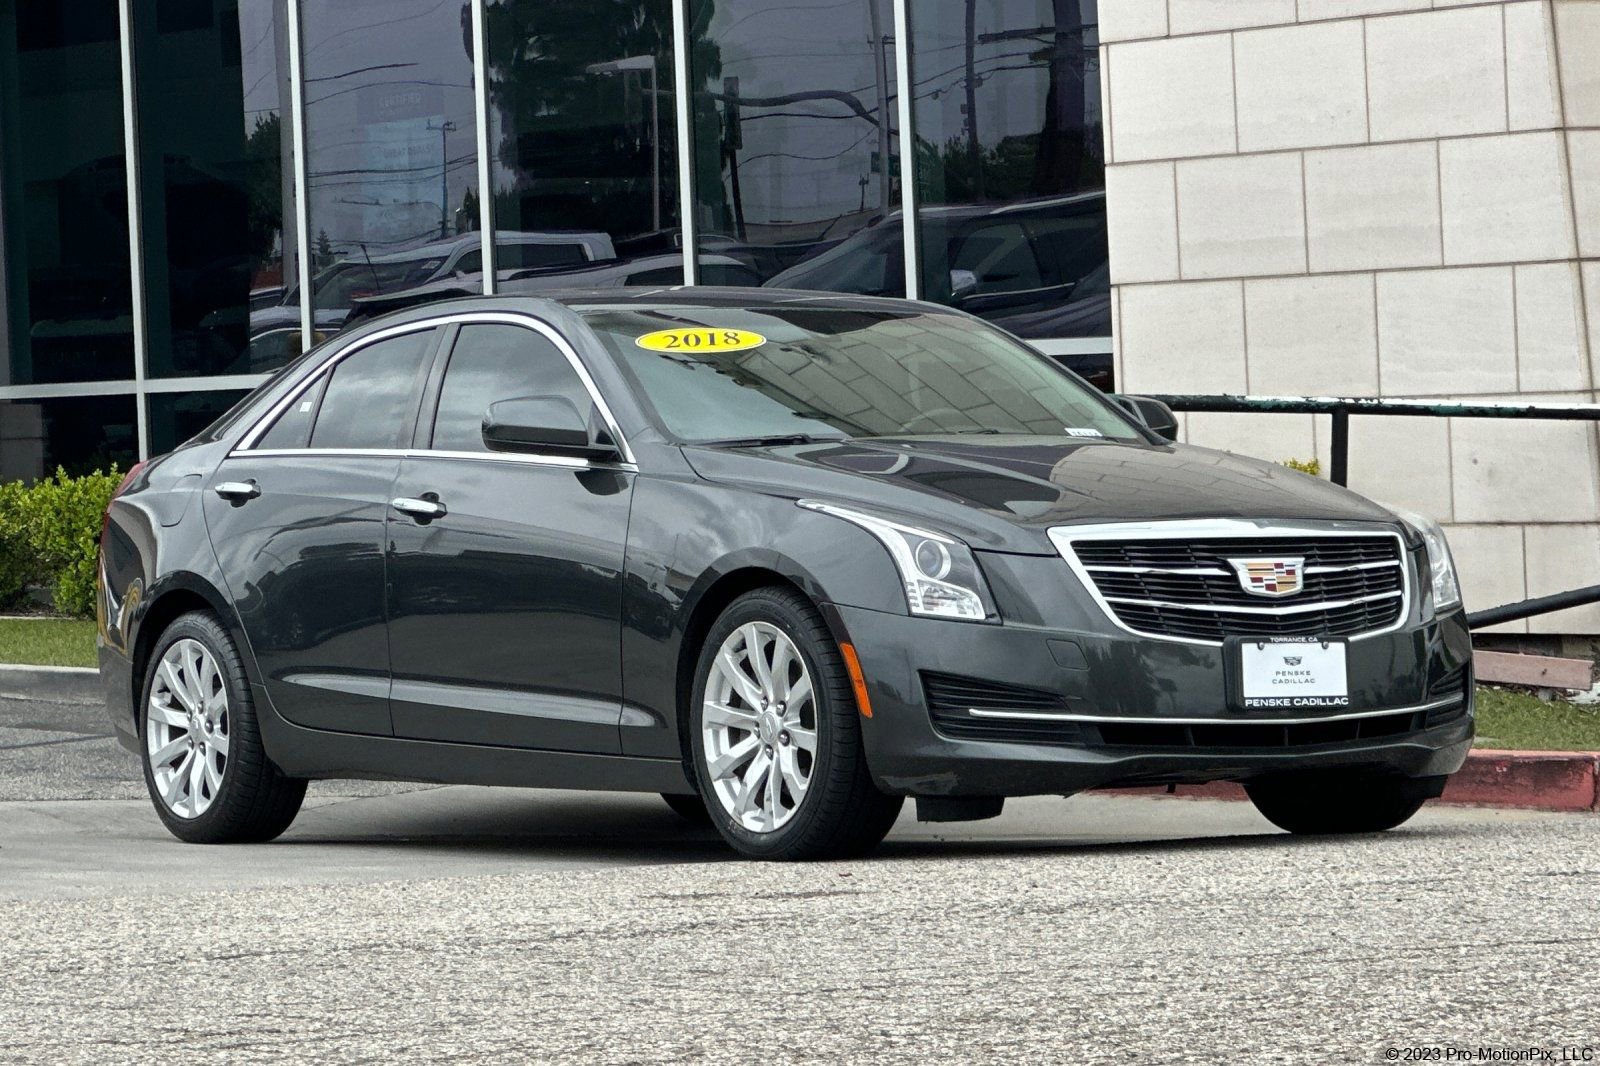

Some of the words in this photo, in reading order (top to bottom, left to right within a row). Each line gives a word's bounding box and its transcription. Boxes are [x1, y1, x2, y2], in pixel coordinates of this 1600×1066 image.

[663, 332, 741, 348] 2018
[1245, 698, 1291, 707] PENSKE
[1293, 697, 1349, 706] CADILLAC
